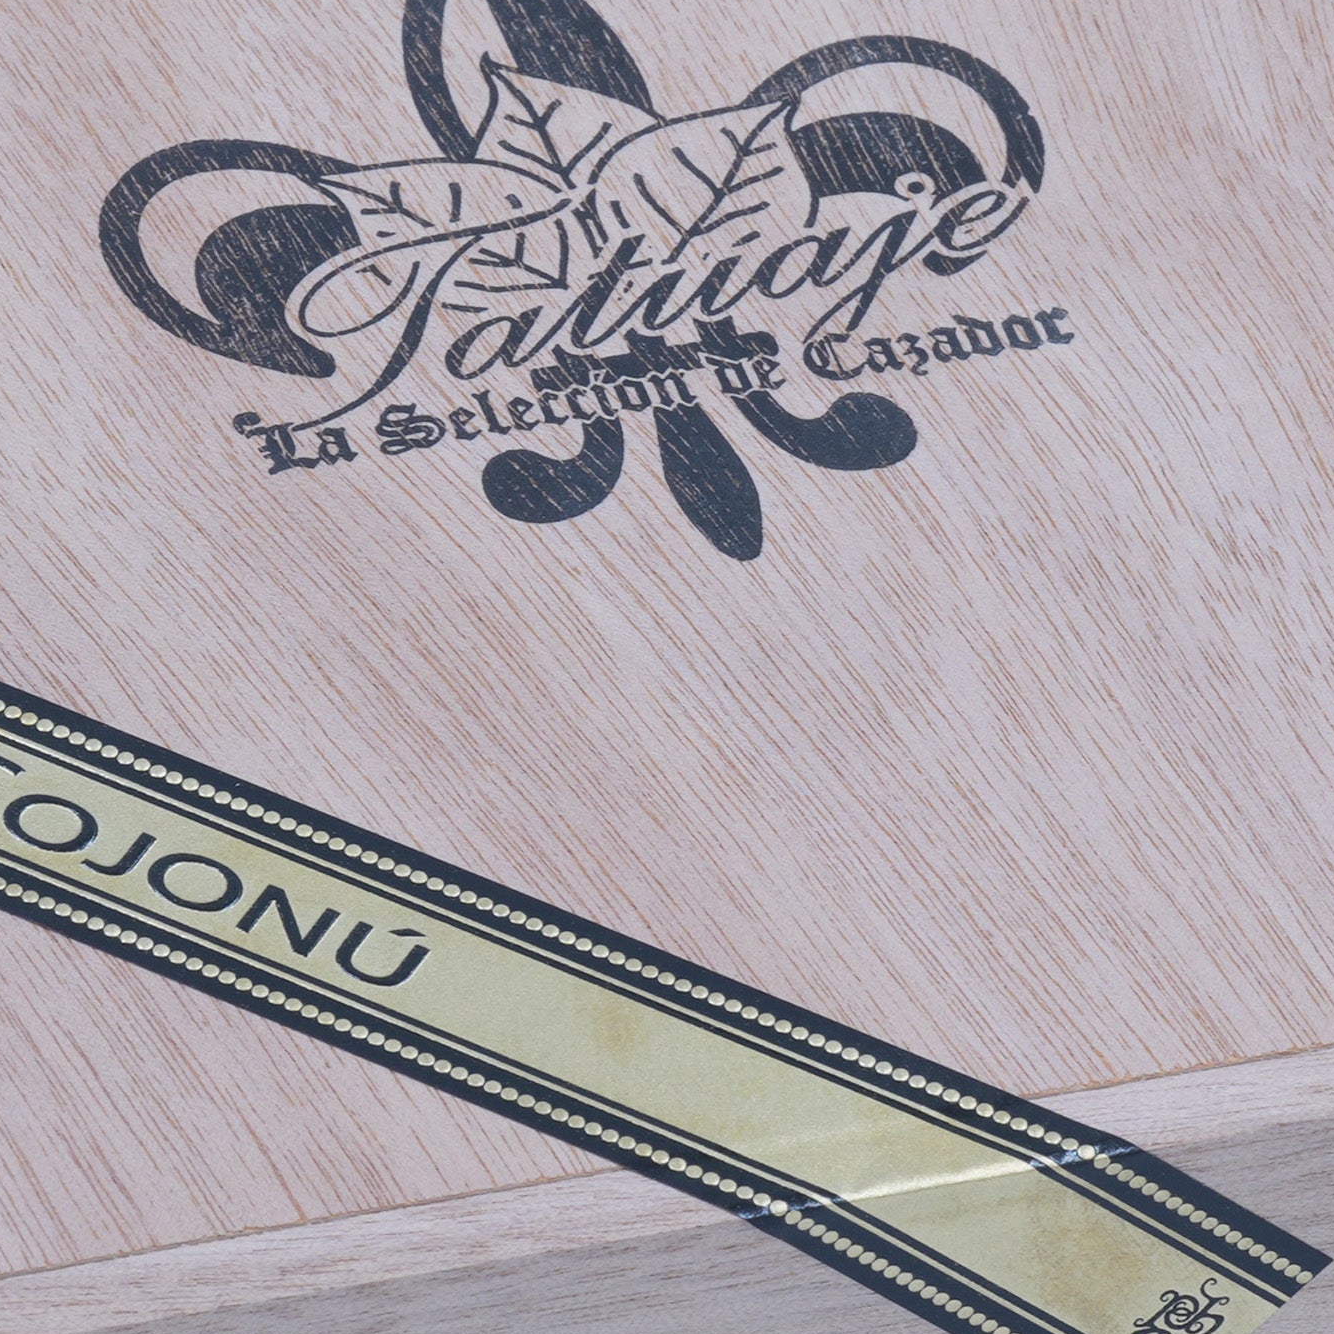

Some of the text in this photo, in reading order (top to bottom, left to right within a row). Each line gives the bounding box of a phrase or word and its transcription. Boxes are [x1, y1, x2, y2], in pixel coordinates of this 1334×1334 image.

[232, 410, 359, 475] La
[704, 355, 786, 394] de
[803, 306, 1075, 381] Cazador
[295, 175, 1030, 430] Tatuaje
